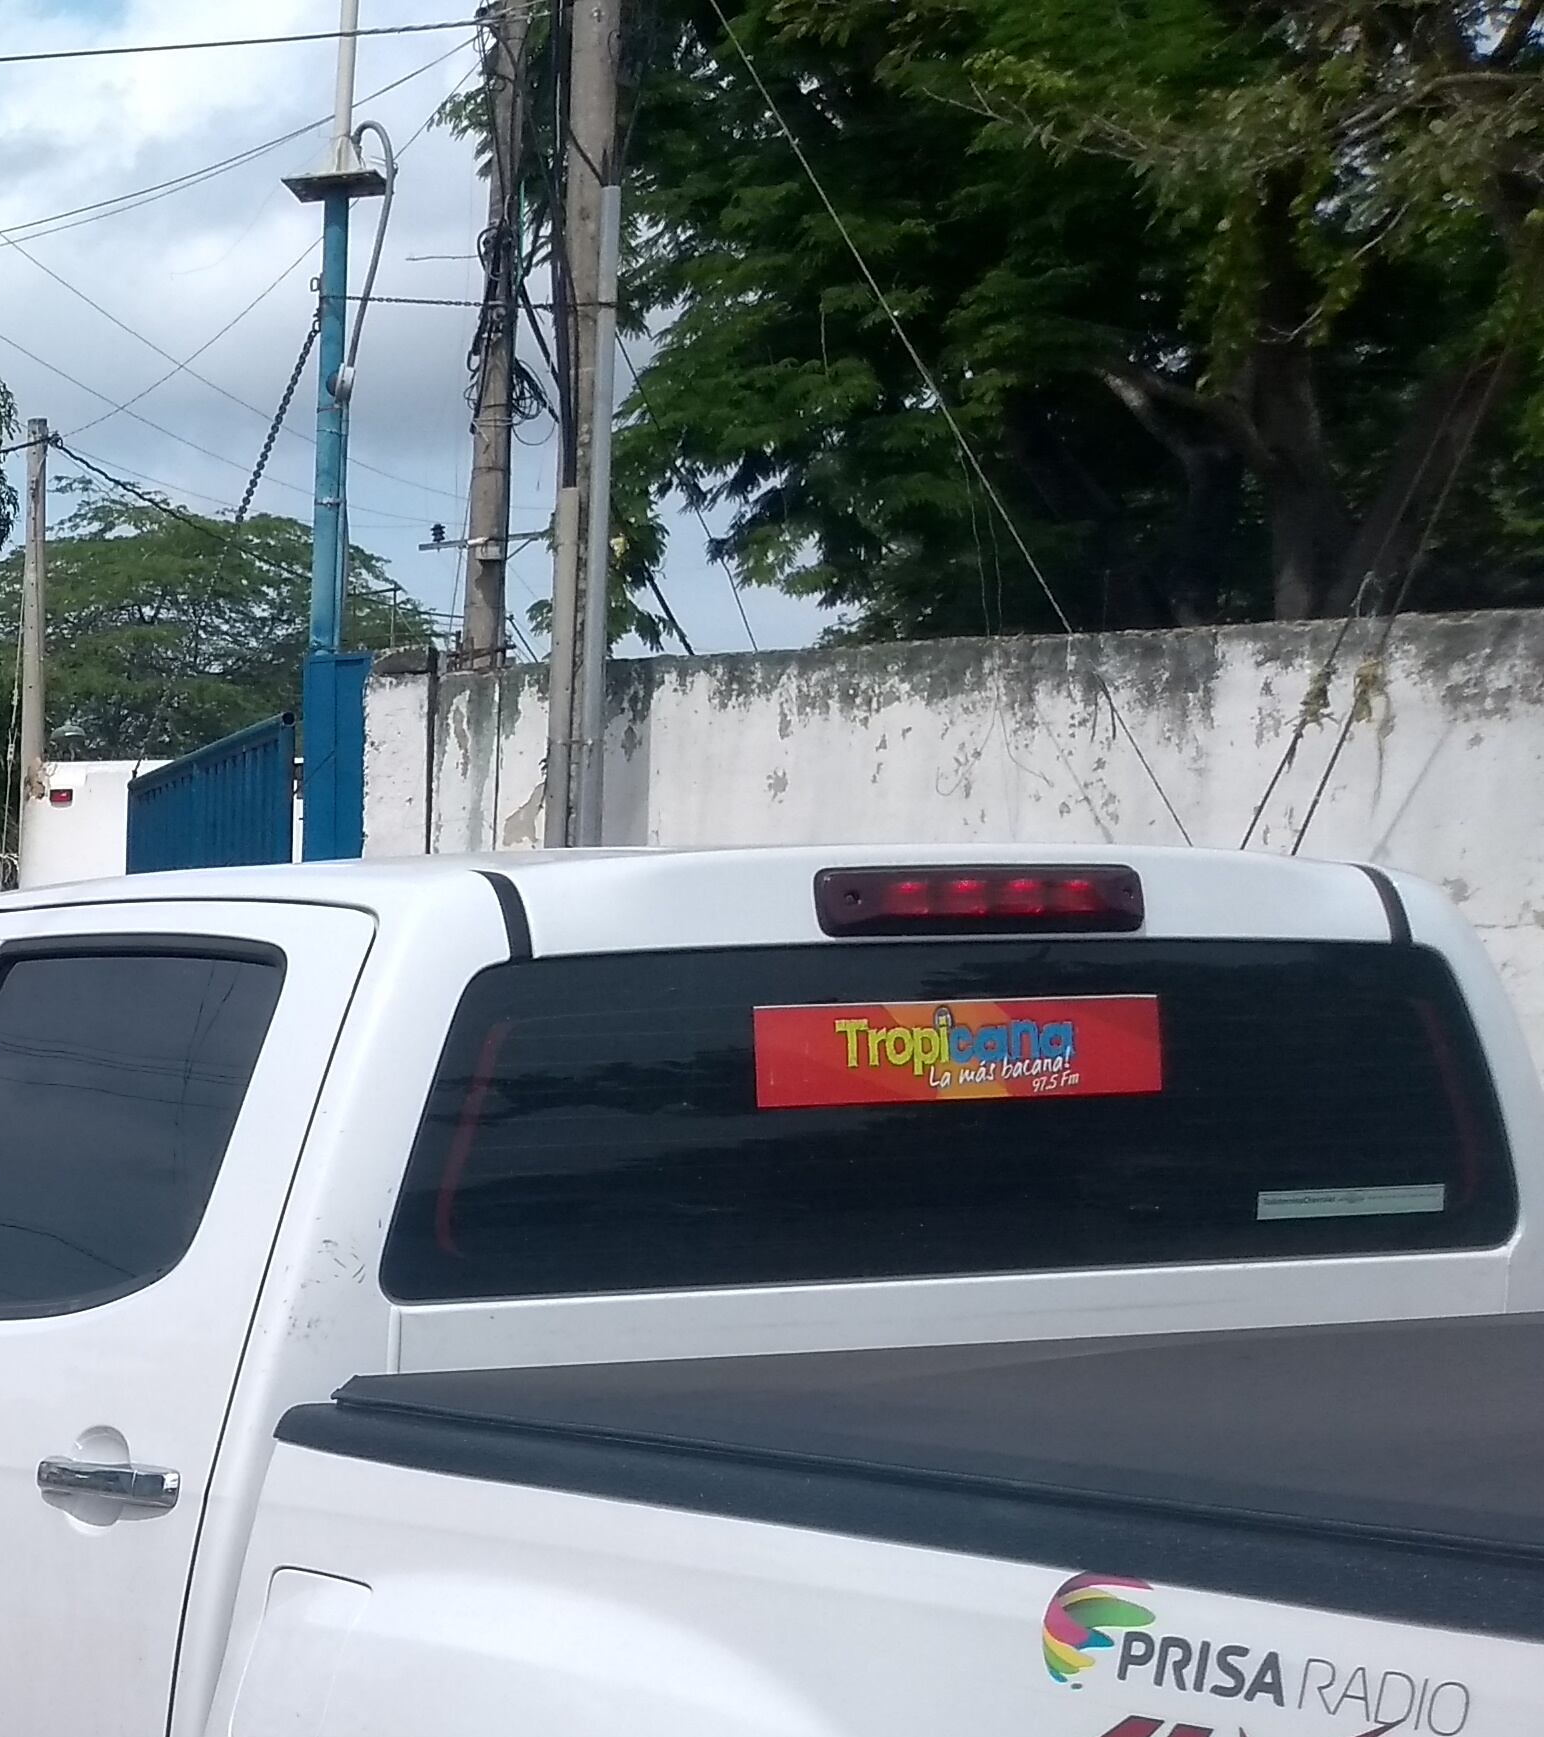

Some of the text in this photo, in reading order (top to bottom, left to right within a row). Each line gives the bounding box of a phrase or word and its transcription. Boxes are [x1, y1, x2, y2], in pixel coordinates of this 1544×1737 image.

[834, 1009, 1077, 1077] Tropicana
[929, 1046, 1072, 1087] La más bacana!
[1032, 1076, 1058, 1092] 97.5
[1116, 1631, 1470, 1737] PRISA RADIO
